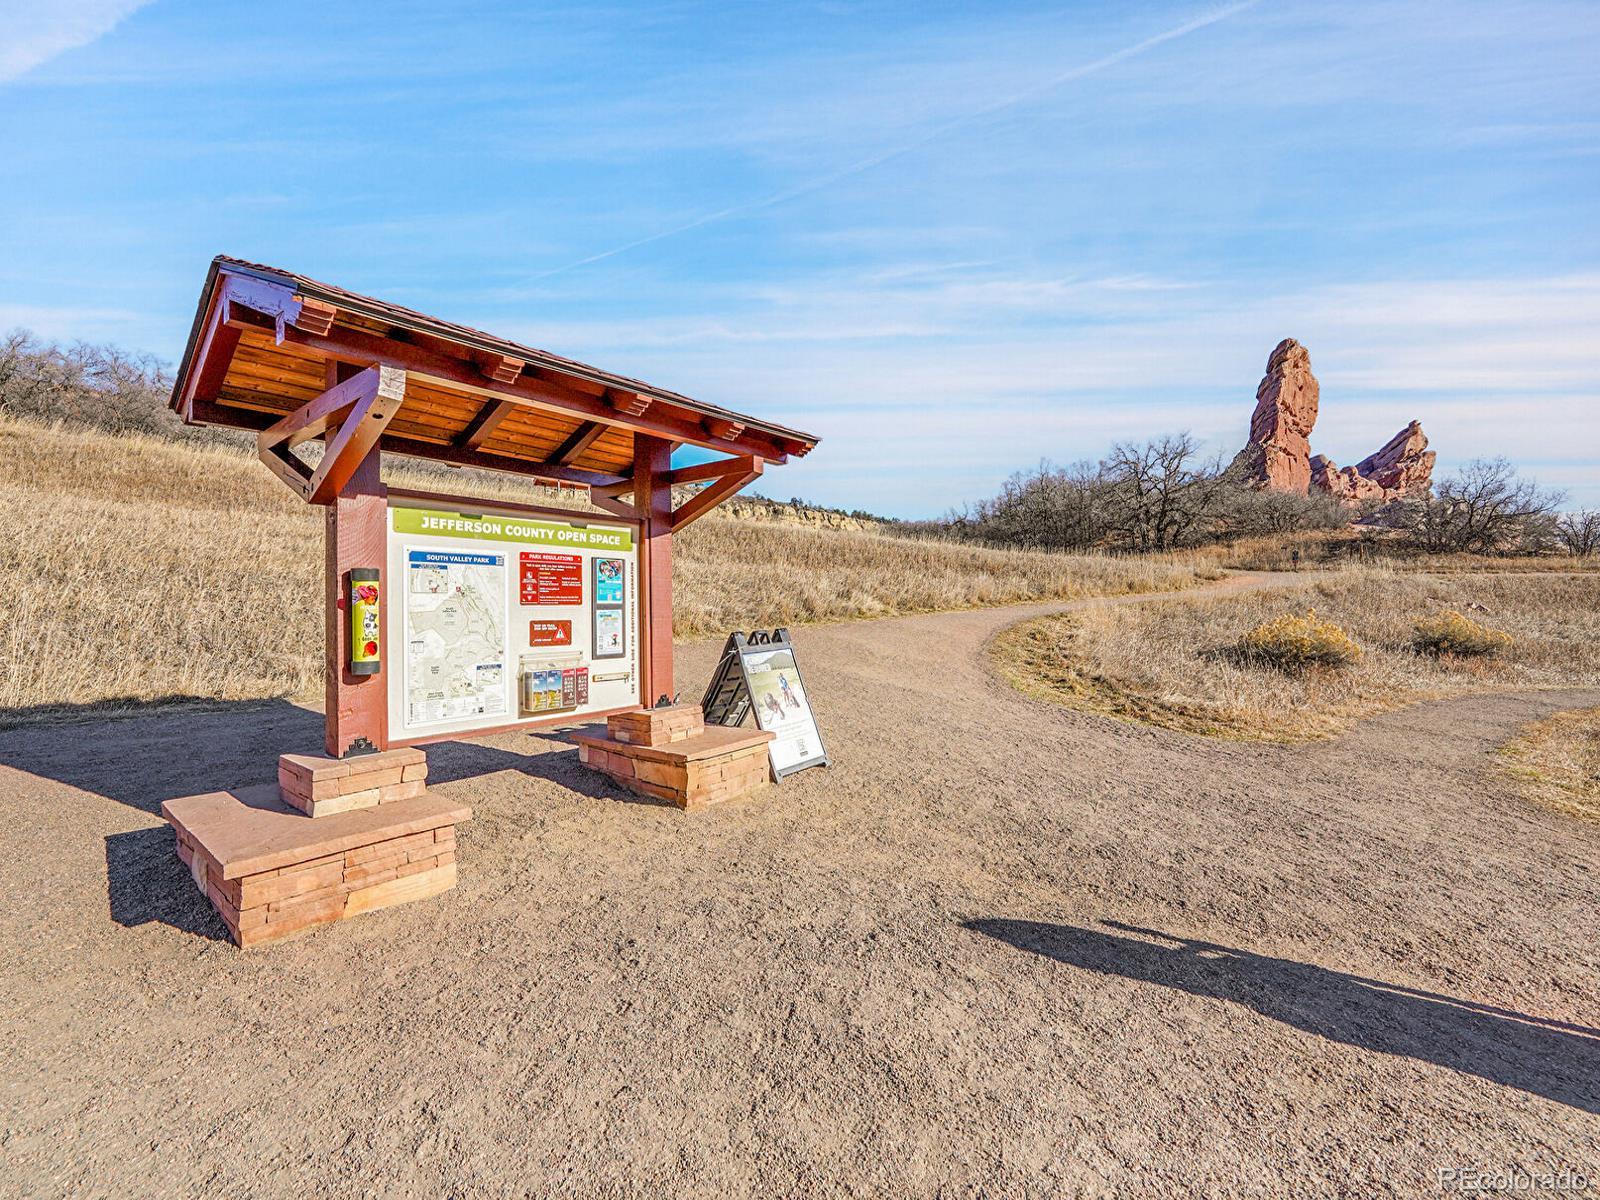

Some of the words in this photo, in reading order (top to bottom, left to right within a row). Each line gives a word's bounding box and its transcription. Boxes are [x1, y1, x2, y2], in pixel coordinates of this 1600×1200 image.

[421, 516, 501, 534] JEFFERSON
[505, 524, 555, 539] COUNTY
[557, 530, 587, 543] OPEN
[589, 533, 621, 545] SPACE
[426, 553, 448, 562] SOUTH
[449, 555, 473, 563] VALLEY
